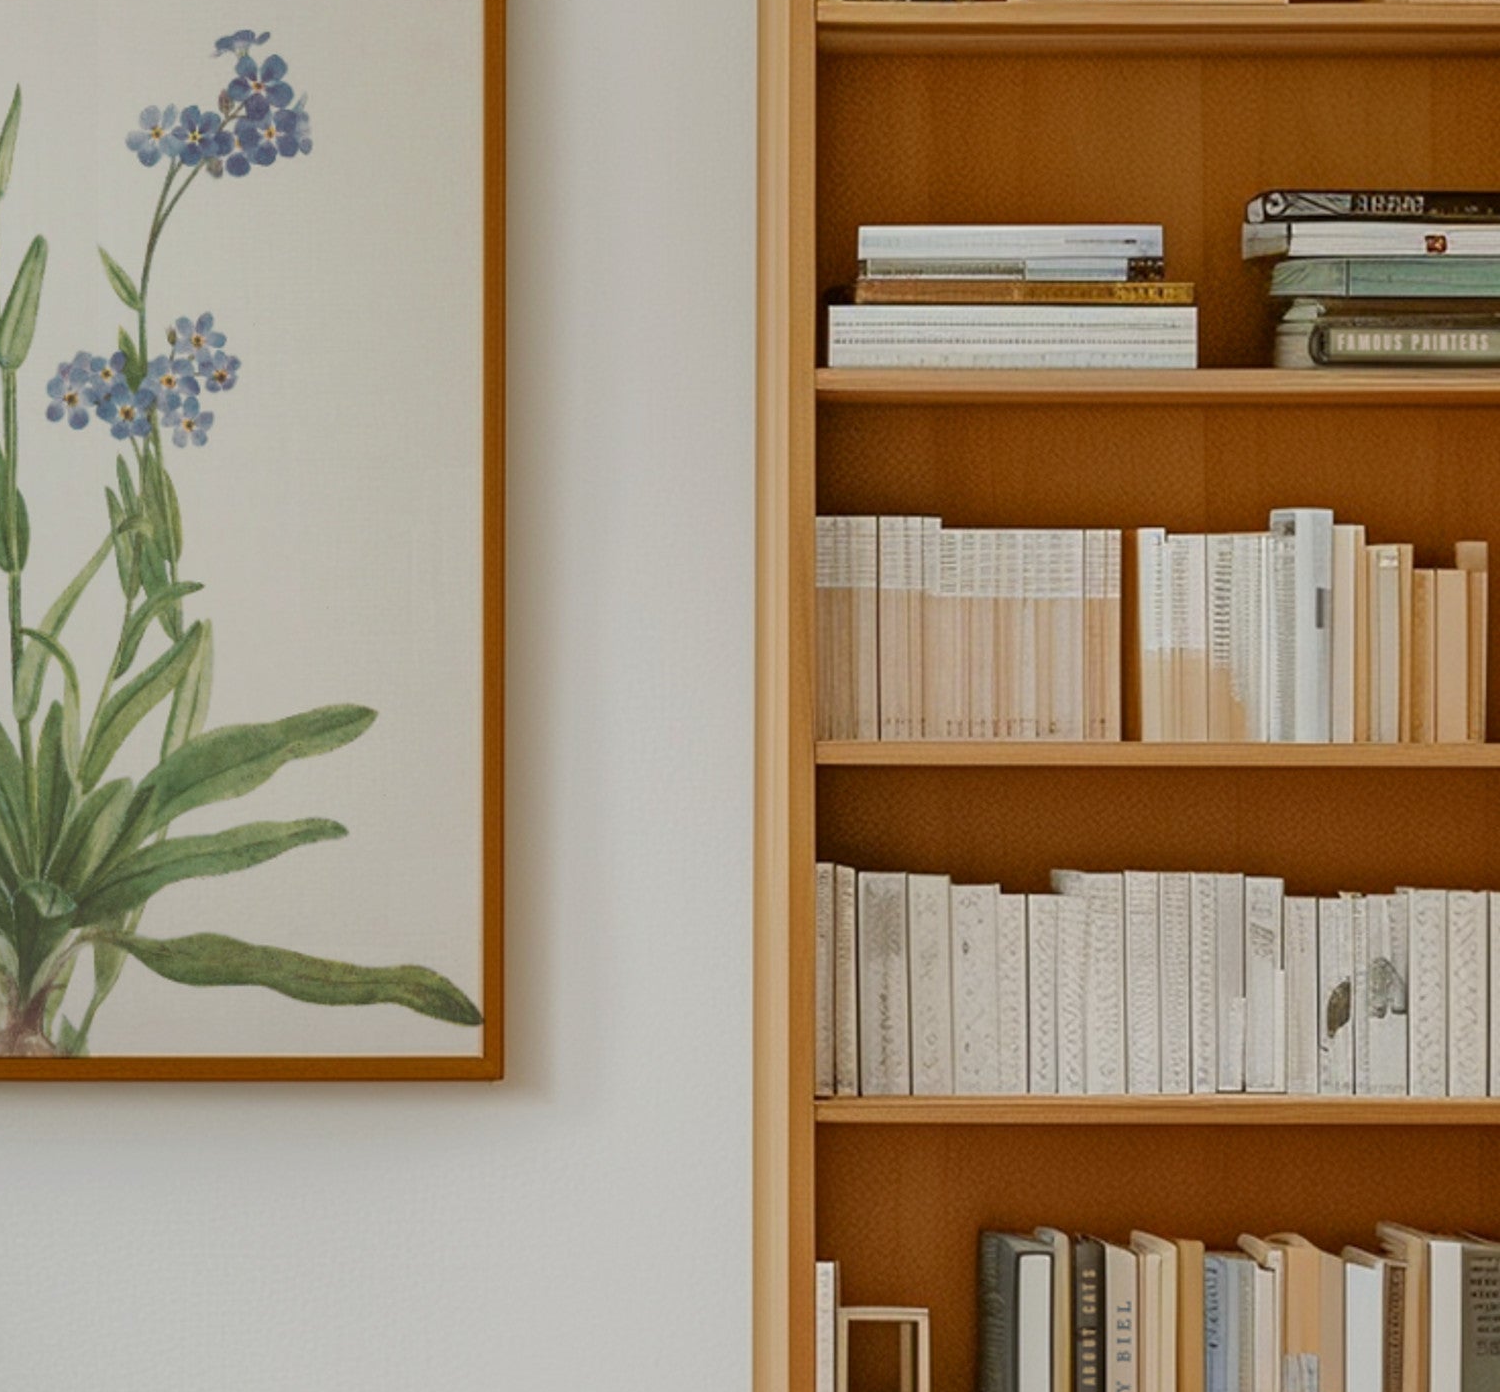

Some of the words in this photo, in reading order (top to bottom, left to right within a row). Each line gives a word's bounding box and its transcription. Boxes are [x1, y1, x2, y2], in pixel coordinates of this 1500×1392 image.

[1336, 333, 1402, 351] FAMOUS
[1411, 333, 1490, 351] PAINTERS
[1082, 1269, 1097, 1314] CATS
[1117, 1300, 1133, 1362] BIEL
[1082, 1328, 1097, 1386] ABOUT
